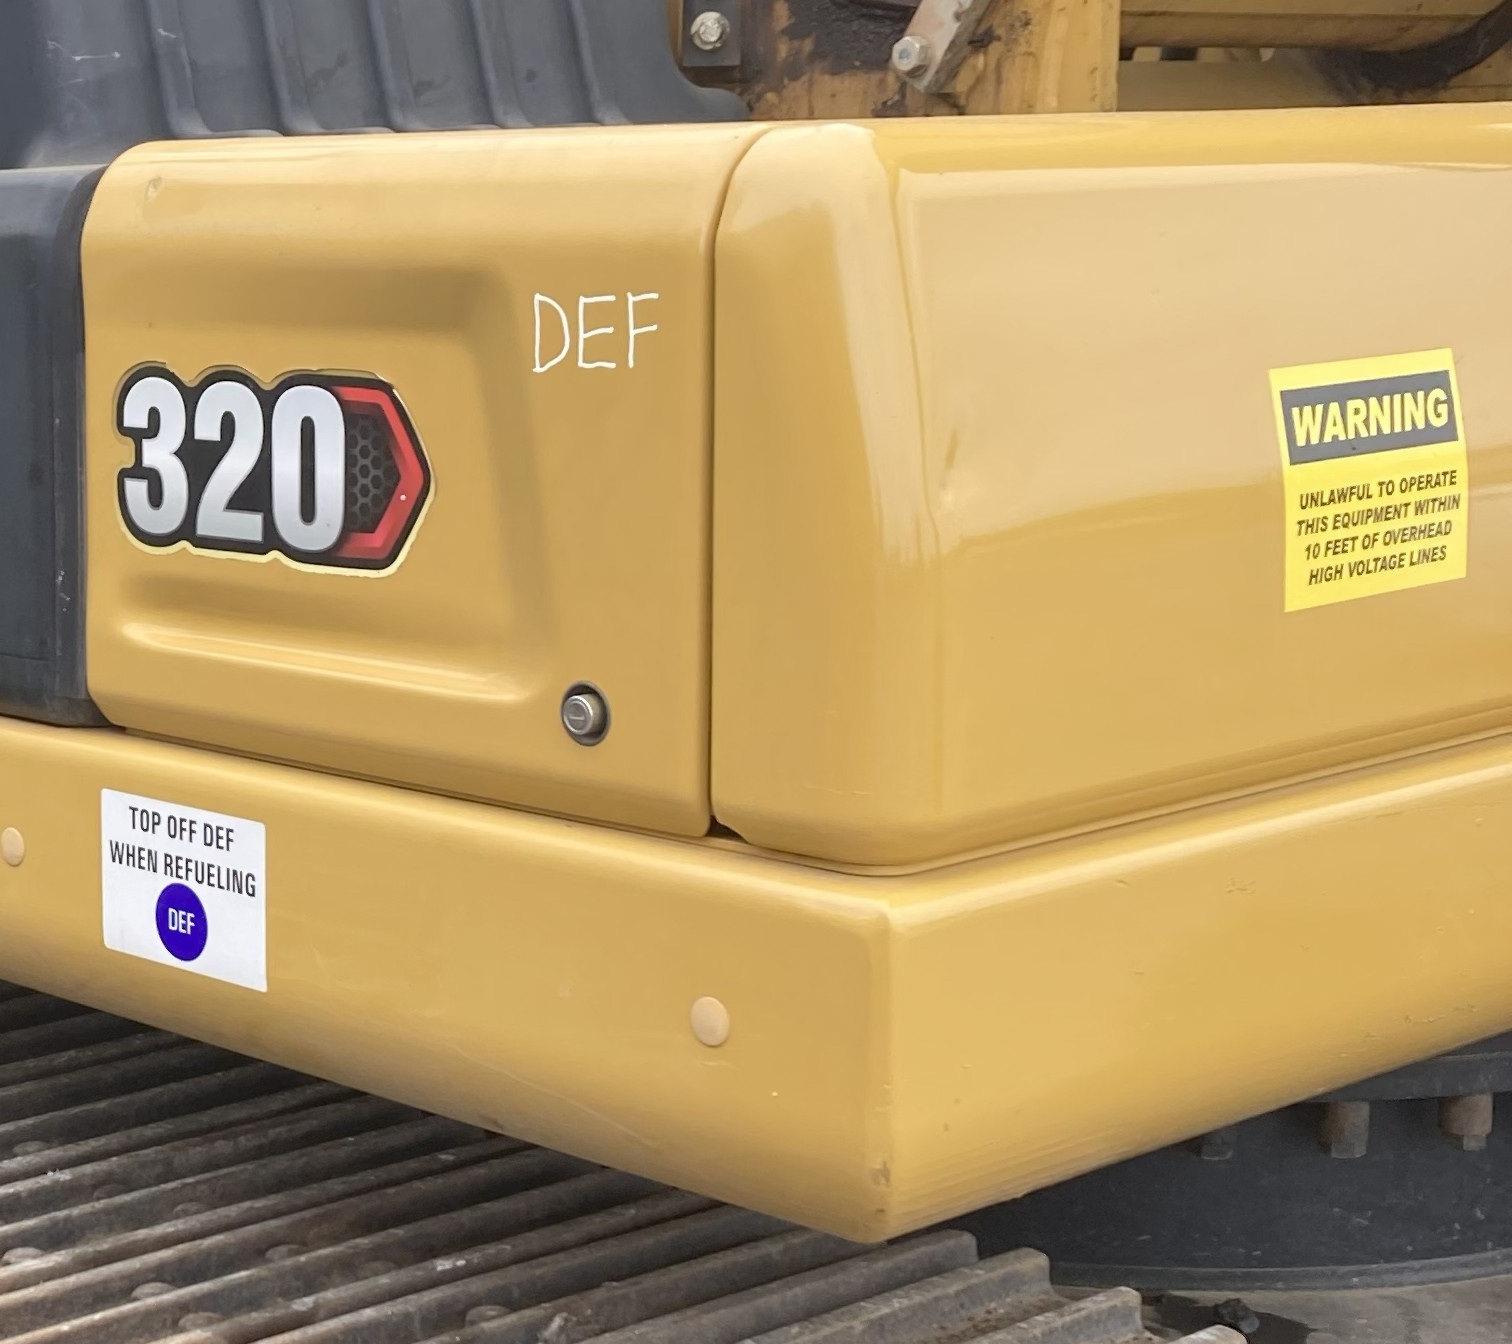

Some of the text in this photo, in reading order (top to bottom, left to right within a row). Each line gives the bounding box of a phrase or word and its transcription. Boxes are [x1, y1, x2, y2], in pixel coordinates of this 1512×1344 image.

[533, 292, 659, 373] DEF
[1291, 387, 1449, 447] WARNING
[123, 376, 345, 552] 320
[1299, 469, 1458, 510] UNLAWFUL TO OPERATE
[1296, 493, 1462, 536] THIS EQUIPMENT WITHIN
[1304, 519, 1453, 561] 10 FEET OF OVERHEAD
[1308, 545, 1447, 586] HIGH VOLTAGE LINES
[129, 806, 235, 852] TOP OFF DEF
[110, 839, 256, 898] WHEN REFUELING
[168, 907, 195, 935] DEF
